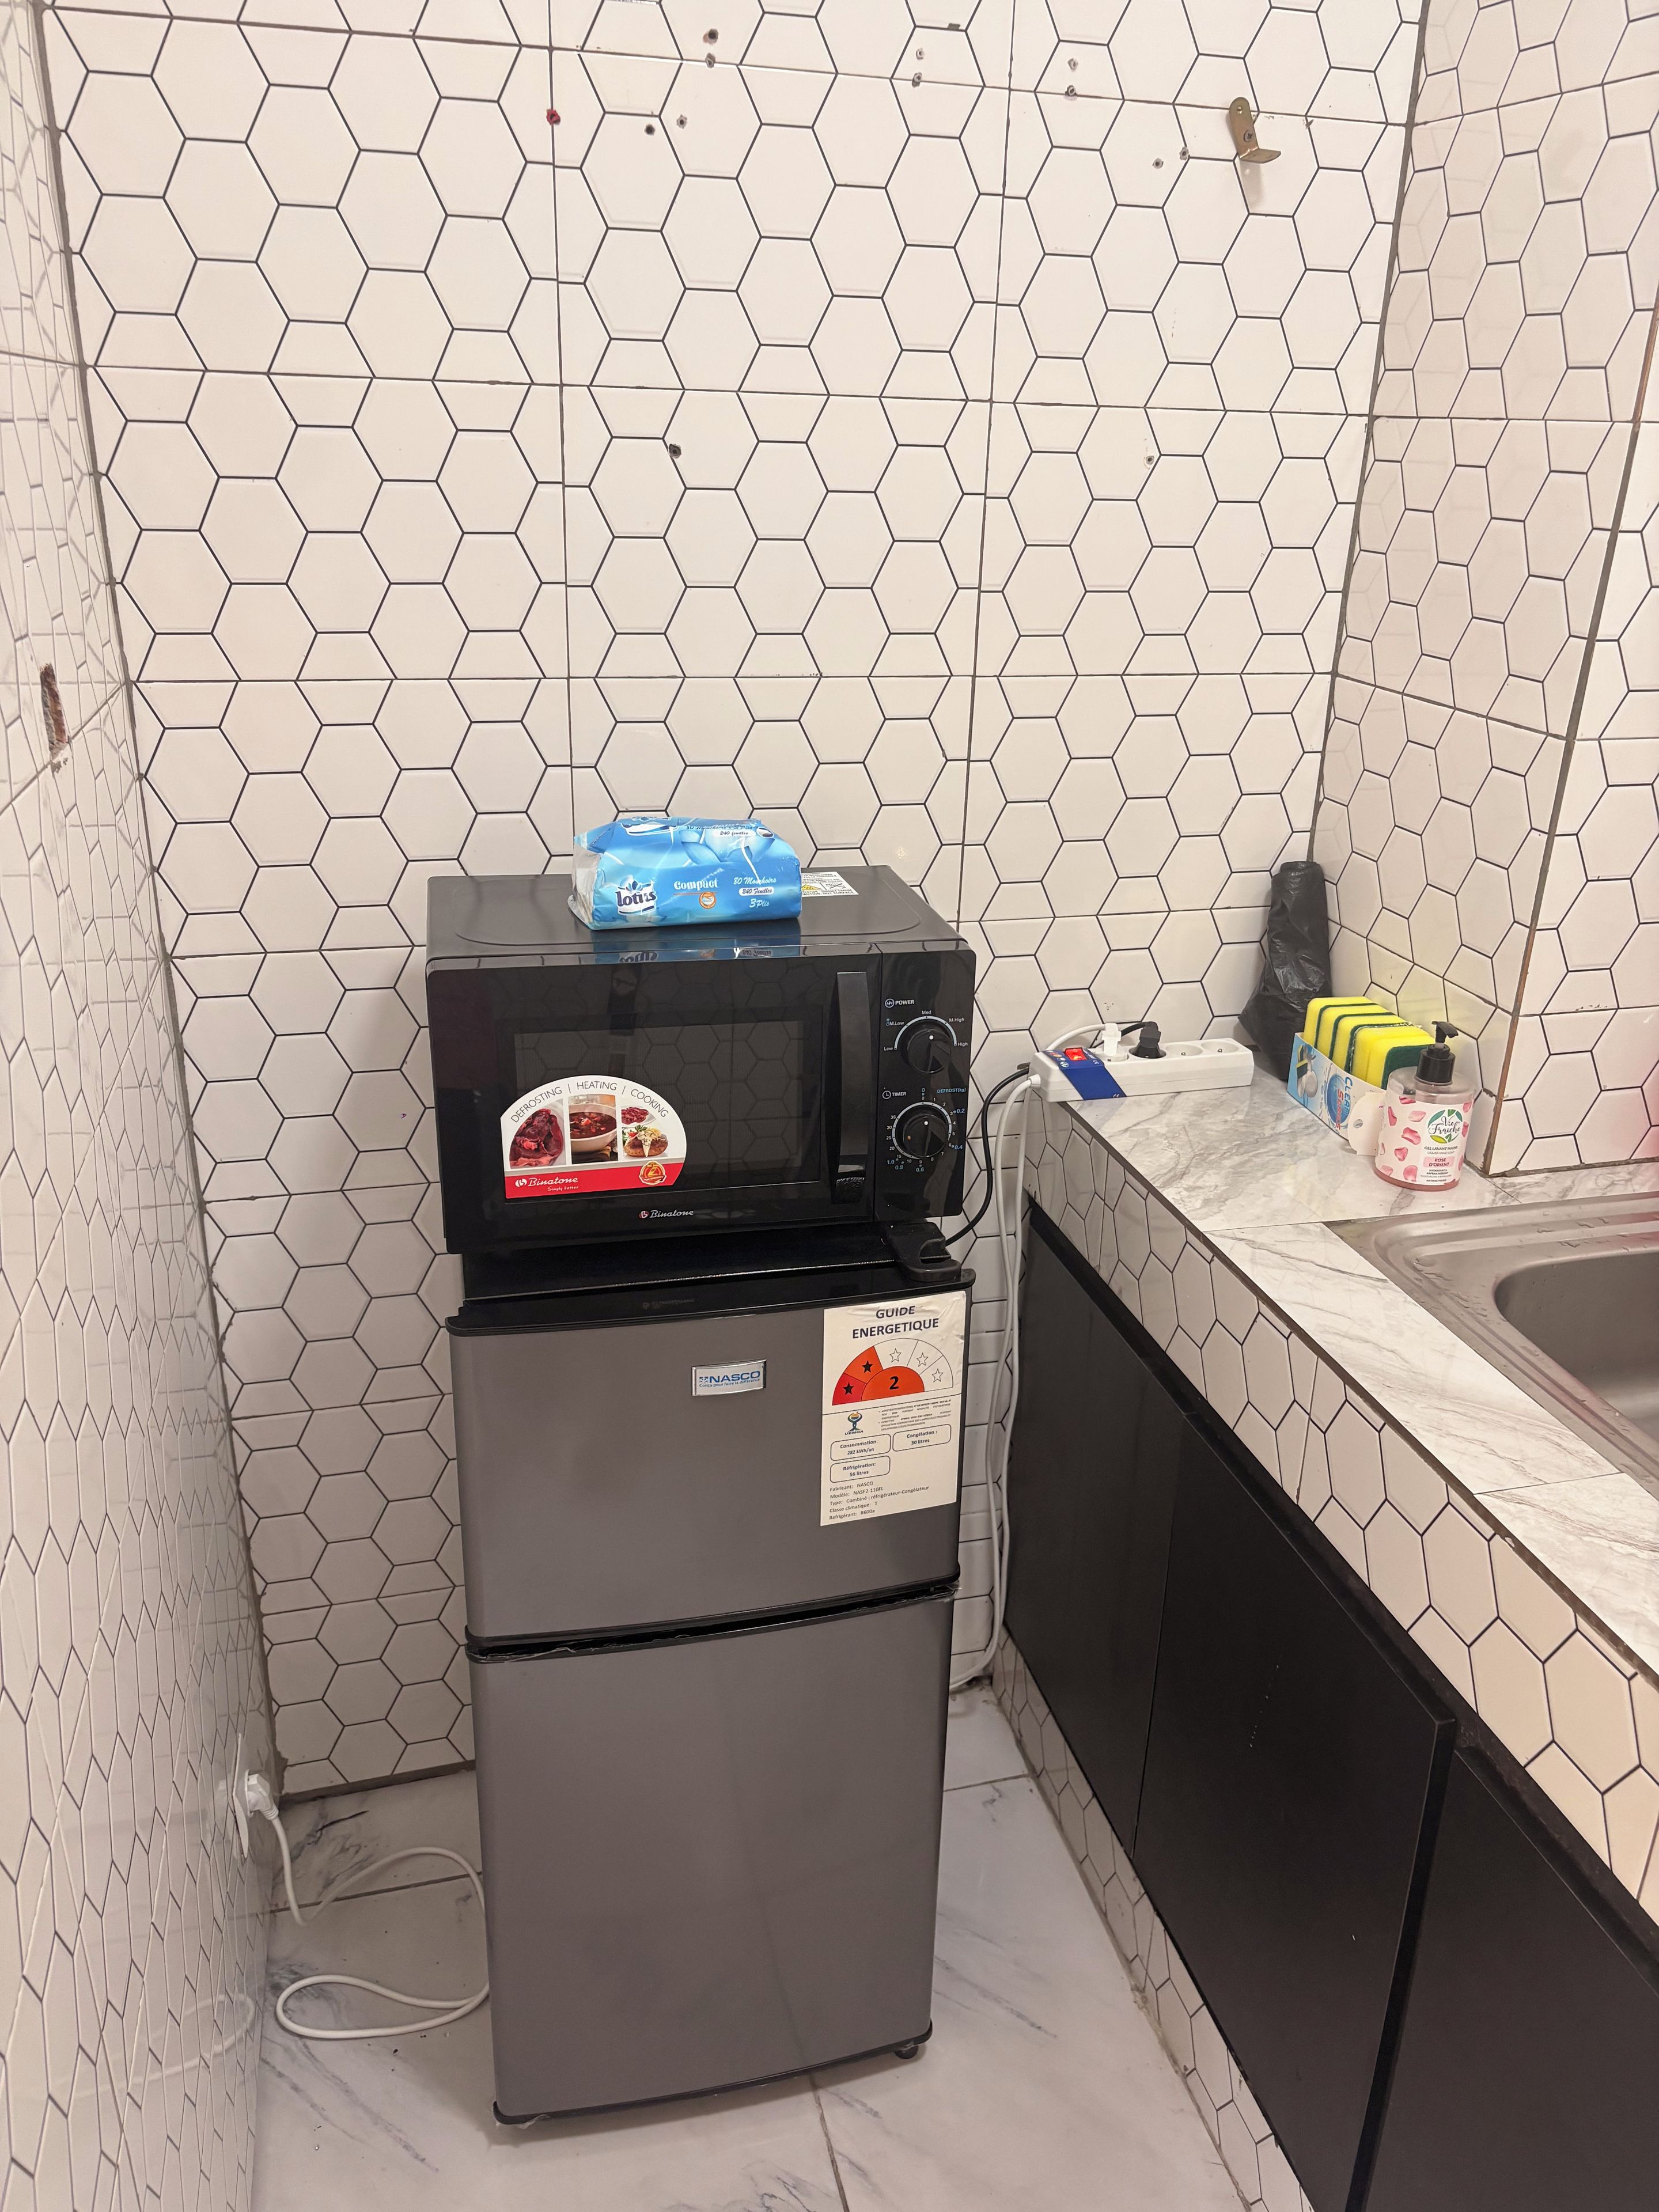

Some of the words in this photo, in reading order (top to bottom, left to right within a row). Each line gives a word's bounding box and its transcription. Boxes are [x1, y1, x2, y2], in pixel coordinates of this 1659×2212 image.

[673, 877, 718, 891] Compact
[733, 877, 743, 885] 80
[615, 891, 657, 907] lotus
[756, 900, 770, 908] Plis
[510, 1086, 562, 1123] DEFROSTING
[577, 1081, 618, 1090] HEATING
[630, 1089, 669, 1118] COOKING
[1441, 1115, 1455, 1127] Vie
[528, 1176, 578, 1187] Binatone
[649, 1209, 694, 1219] Binatone
[876, 1305, 915, 1319] GUIDE
[852, 1318, 940, 1339] ENERGETIQUE
[709, 1370, 761, 1384] NASCO
[889, 1376, 899, 1390] 2
[906, 1430, 935, 1439] Congélation
[840, 1440, 877, 1449] Consommation
[843, 1462, 876, 1471] Réfrigération:
[853, 1486, 884, 1495] NASF2-110FL
[845, 1503, 871, 1511] climatique:
